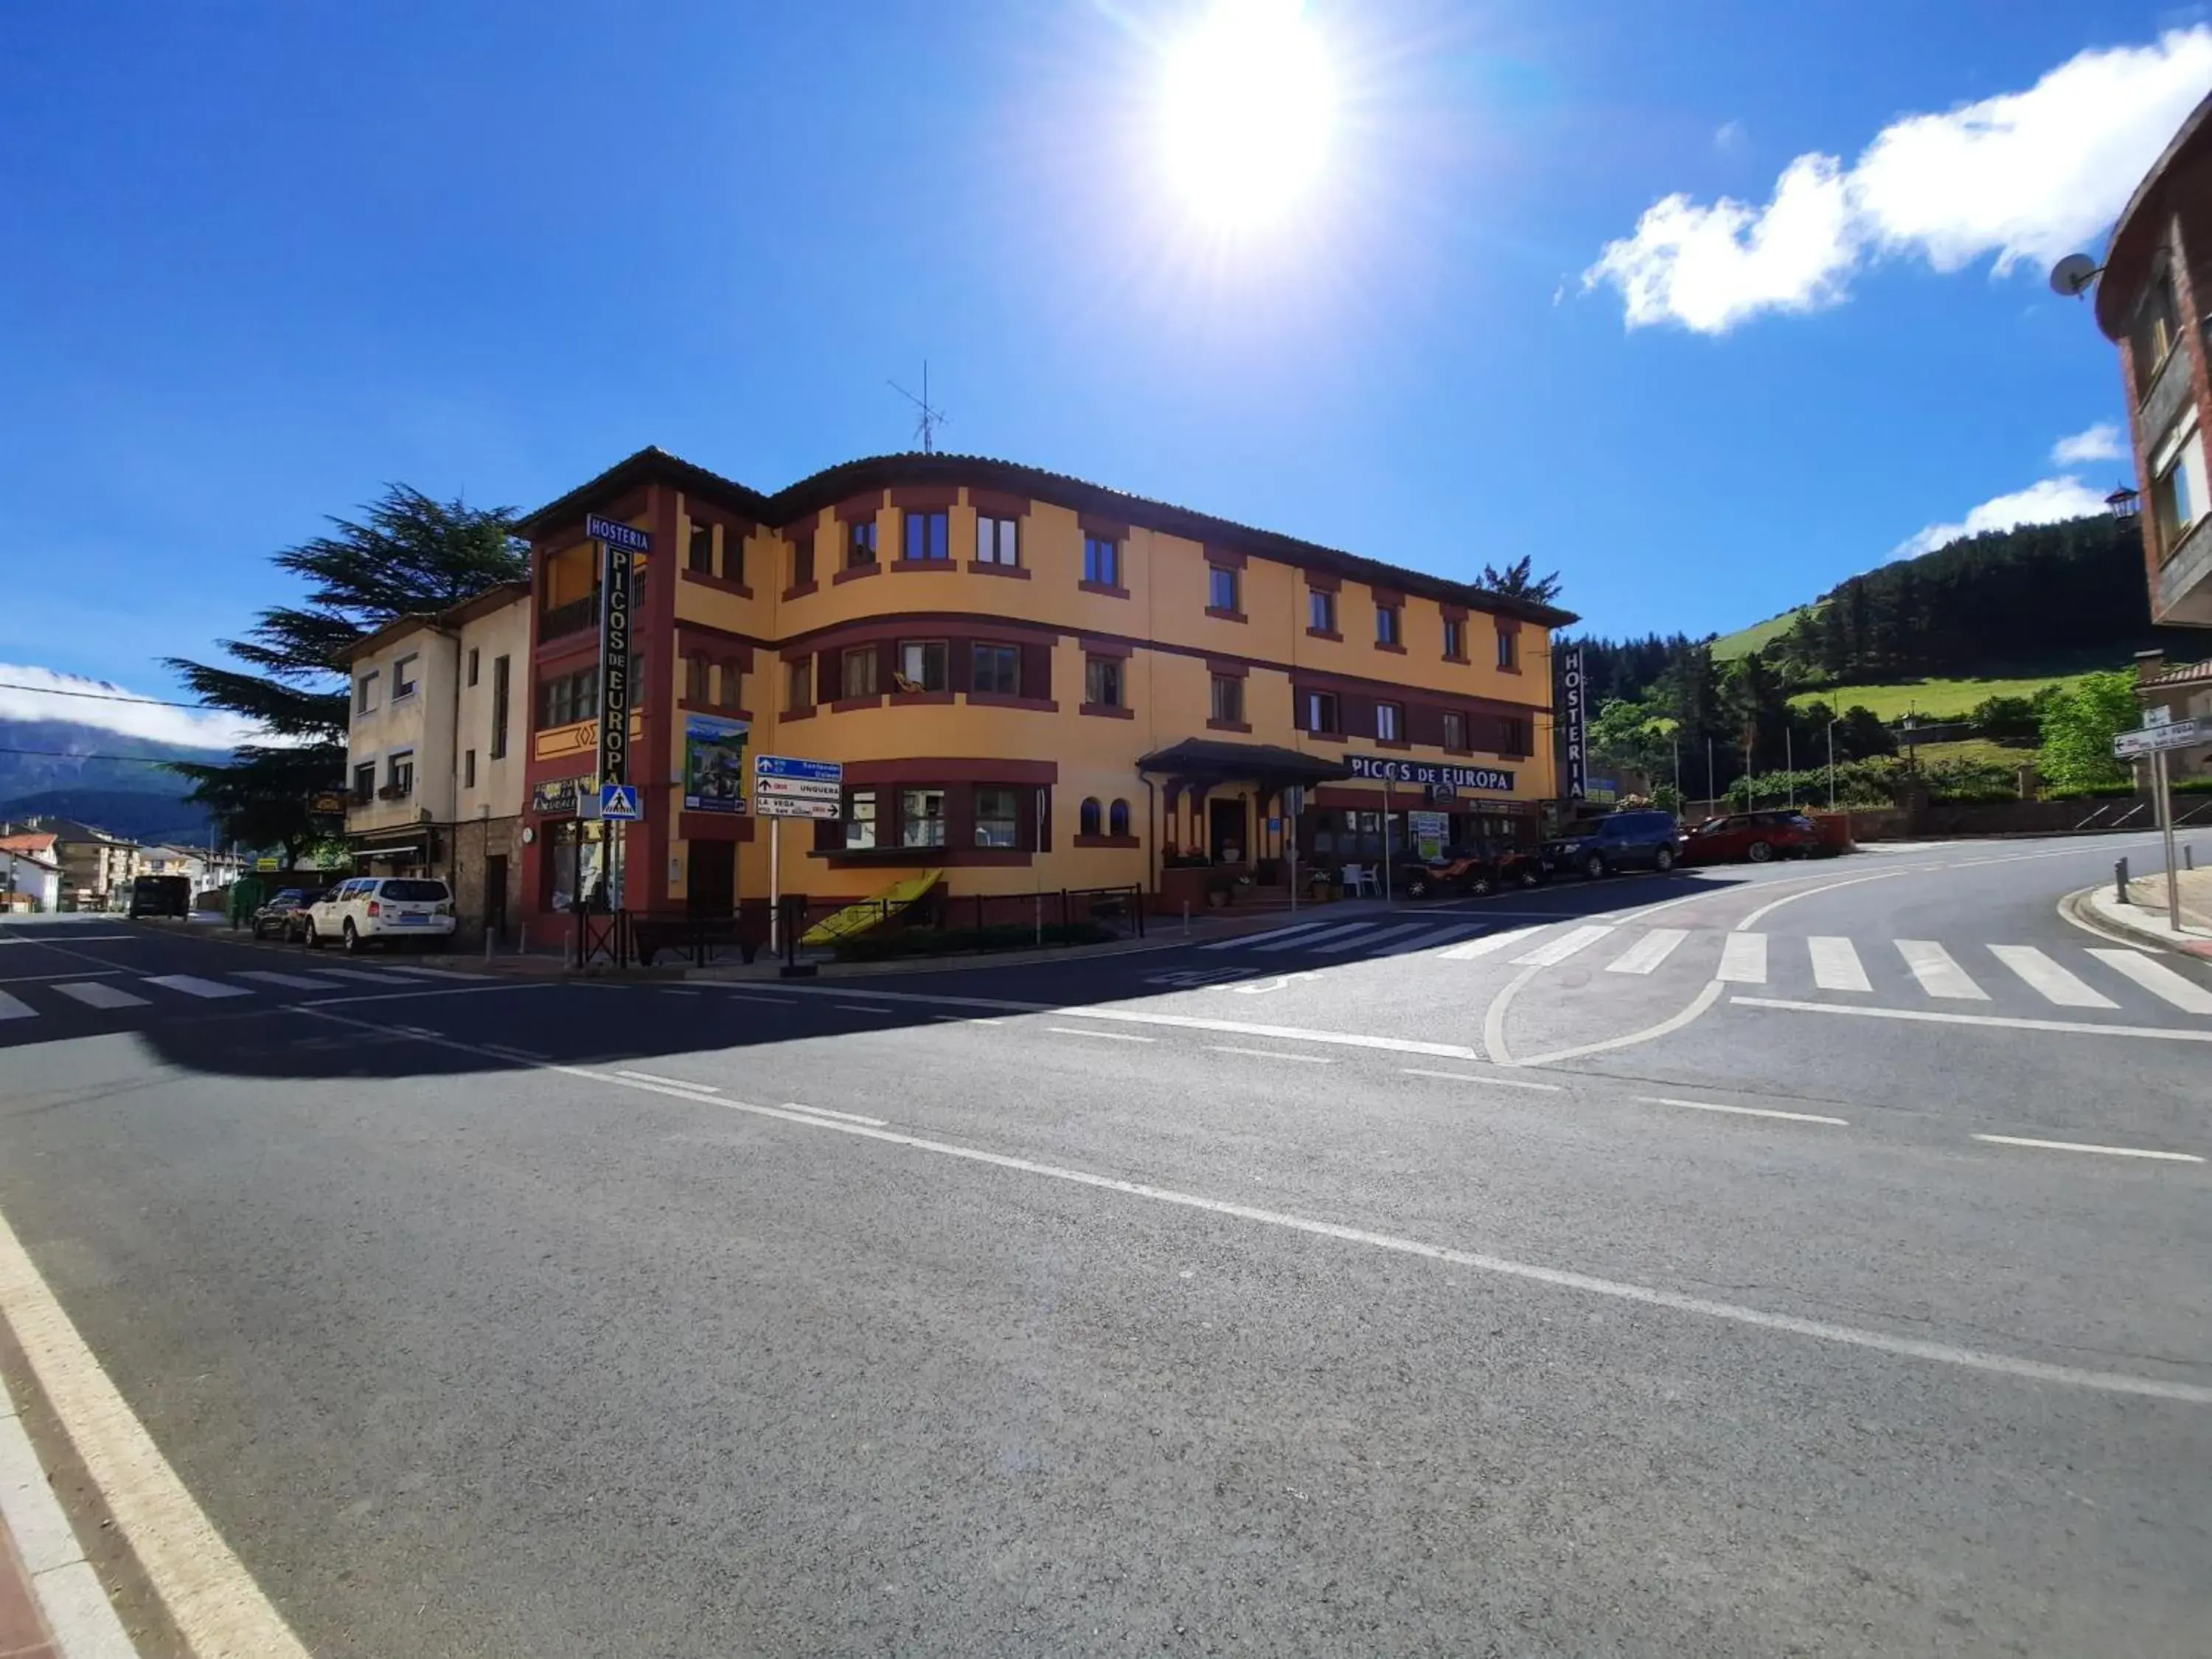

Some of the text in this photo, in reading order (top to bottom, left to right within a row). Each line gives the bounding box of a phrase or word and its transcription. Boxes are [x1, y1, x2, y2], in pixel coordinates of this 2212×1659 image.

[592, 518, 648, 550] HOSTERIA
[606, 551, 626, 785] PICOS DE EUROPA
[1565, 654, 1582, 798] HOSTERIA
[800, 784, 838, 794] UNQUERA
[1418, 768, 1436, 782] DE
[1442, 768, 1509, 790] EUROPA
